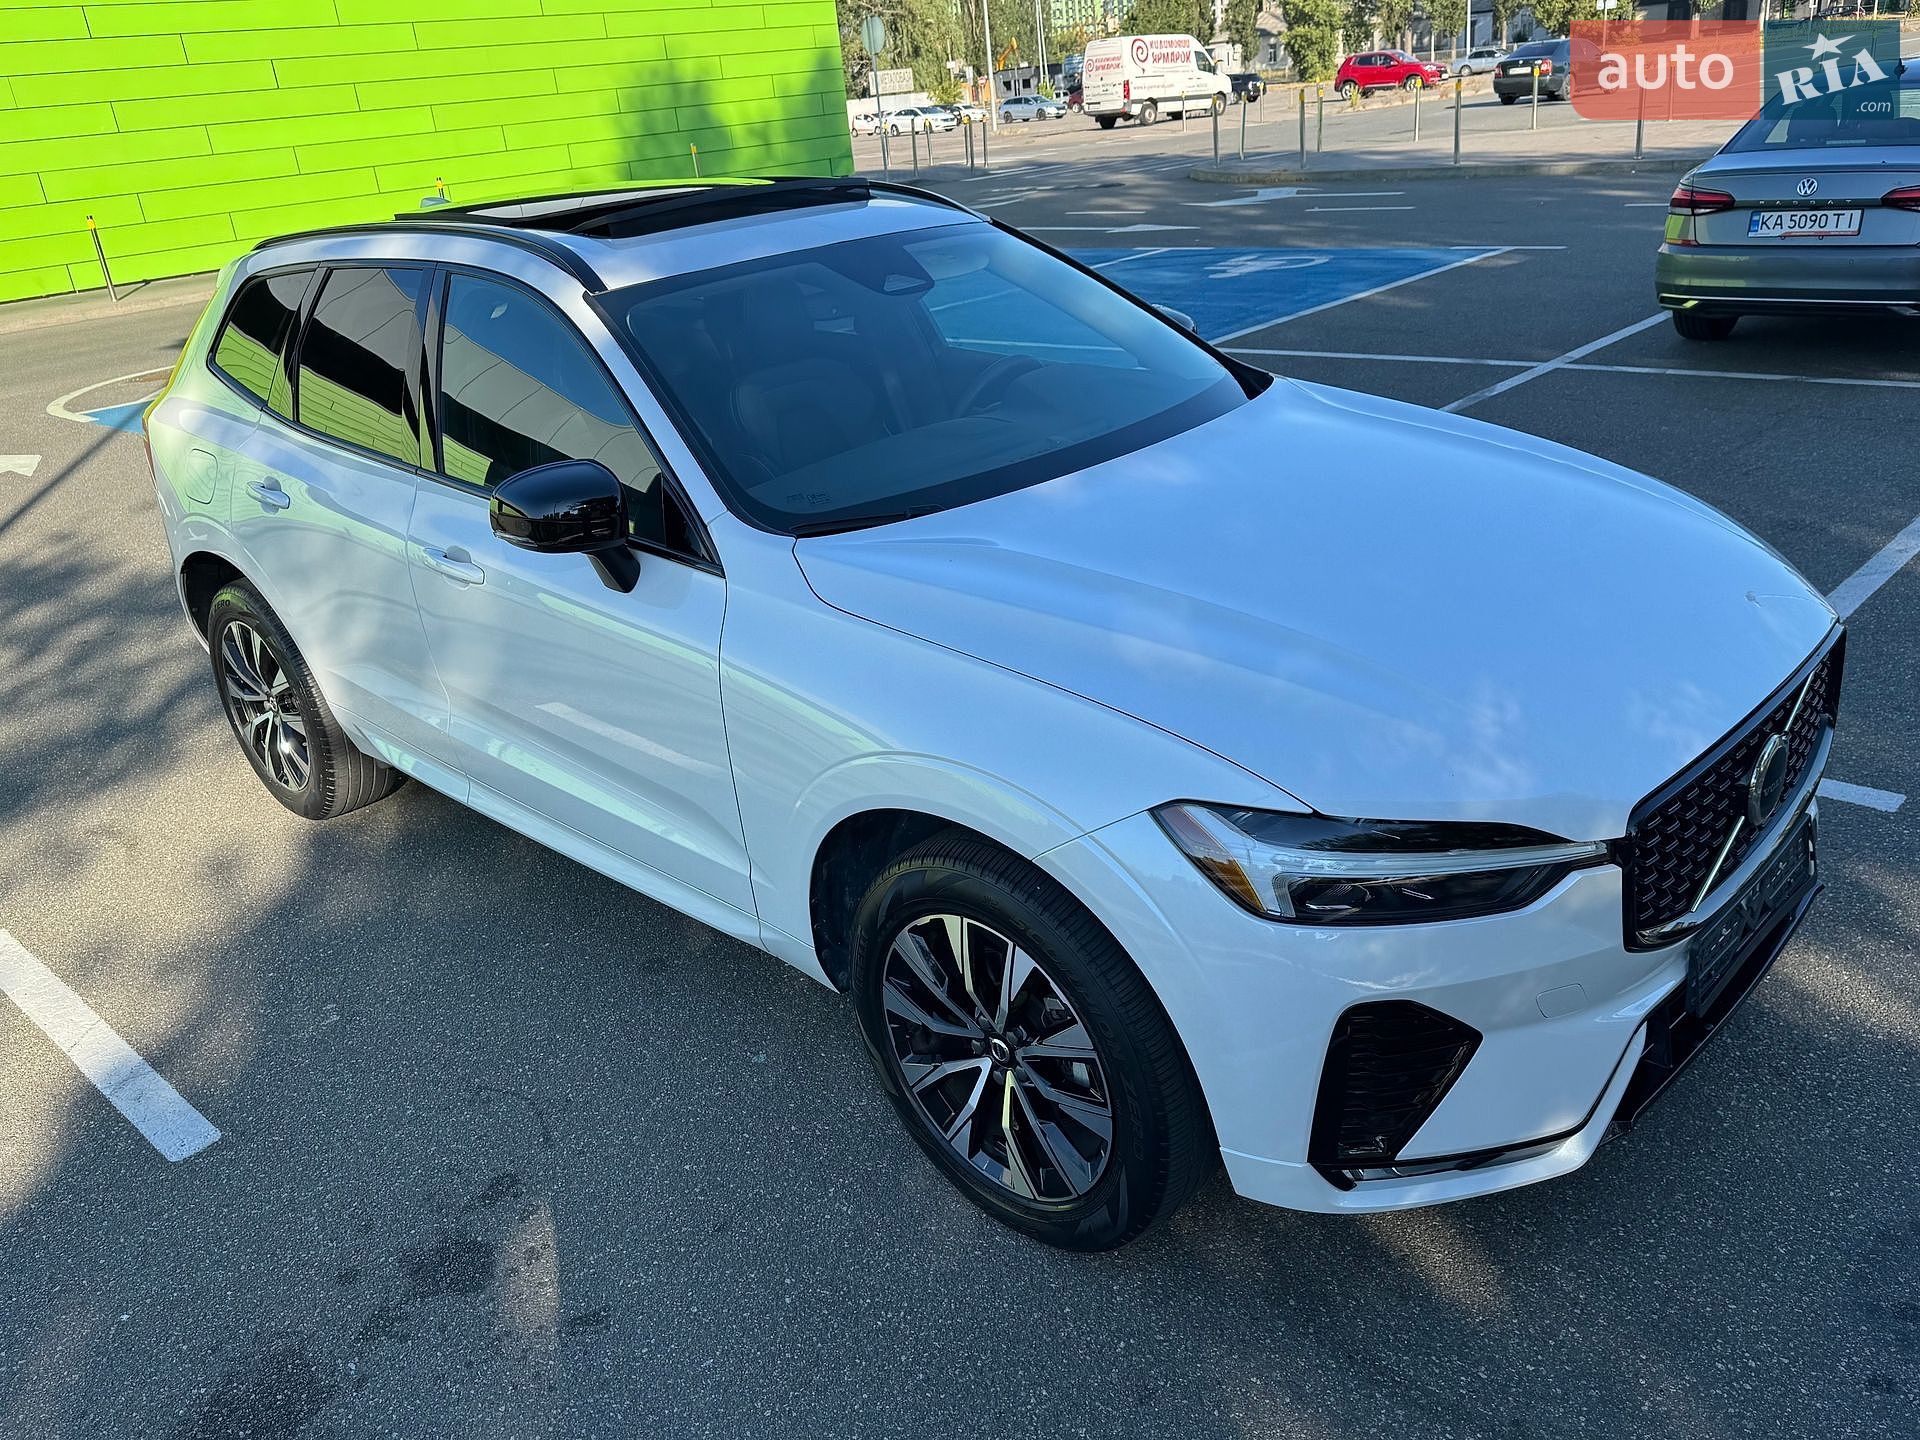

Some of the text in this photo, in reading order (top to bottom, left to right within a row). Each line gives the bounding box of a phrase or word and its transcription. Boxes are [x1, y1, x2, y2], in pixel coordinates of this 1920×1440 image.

[1151, 49, 1191, 64] ЯРМАРОК
[1760, 212, 1854, 230] KA 5090 TI
